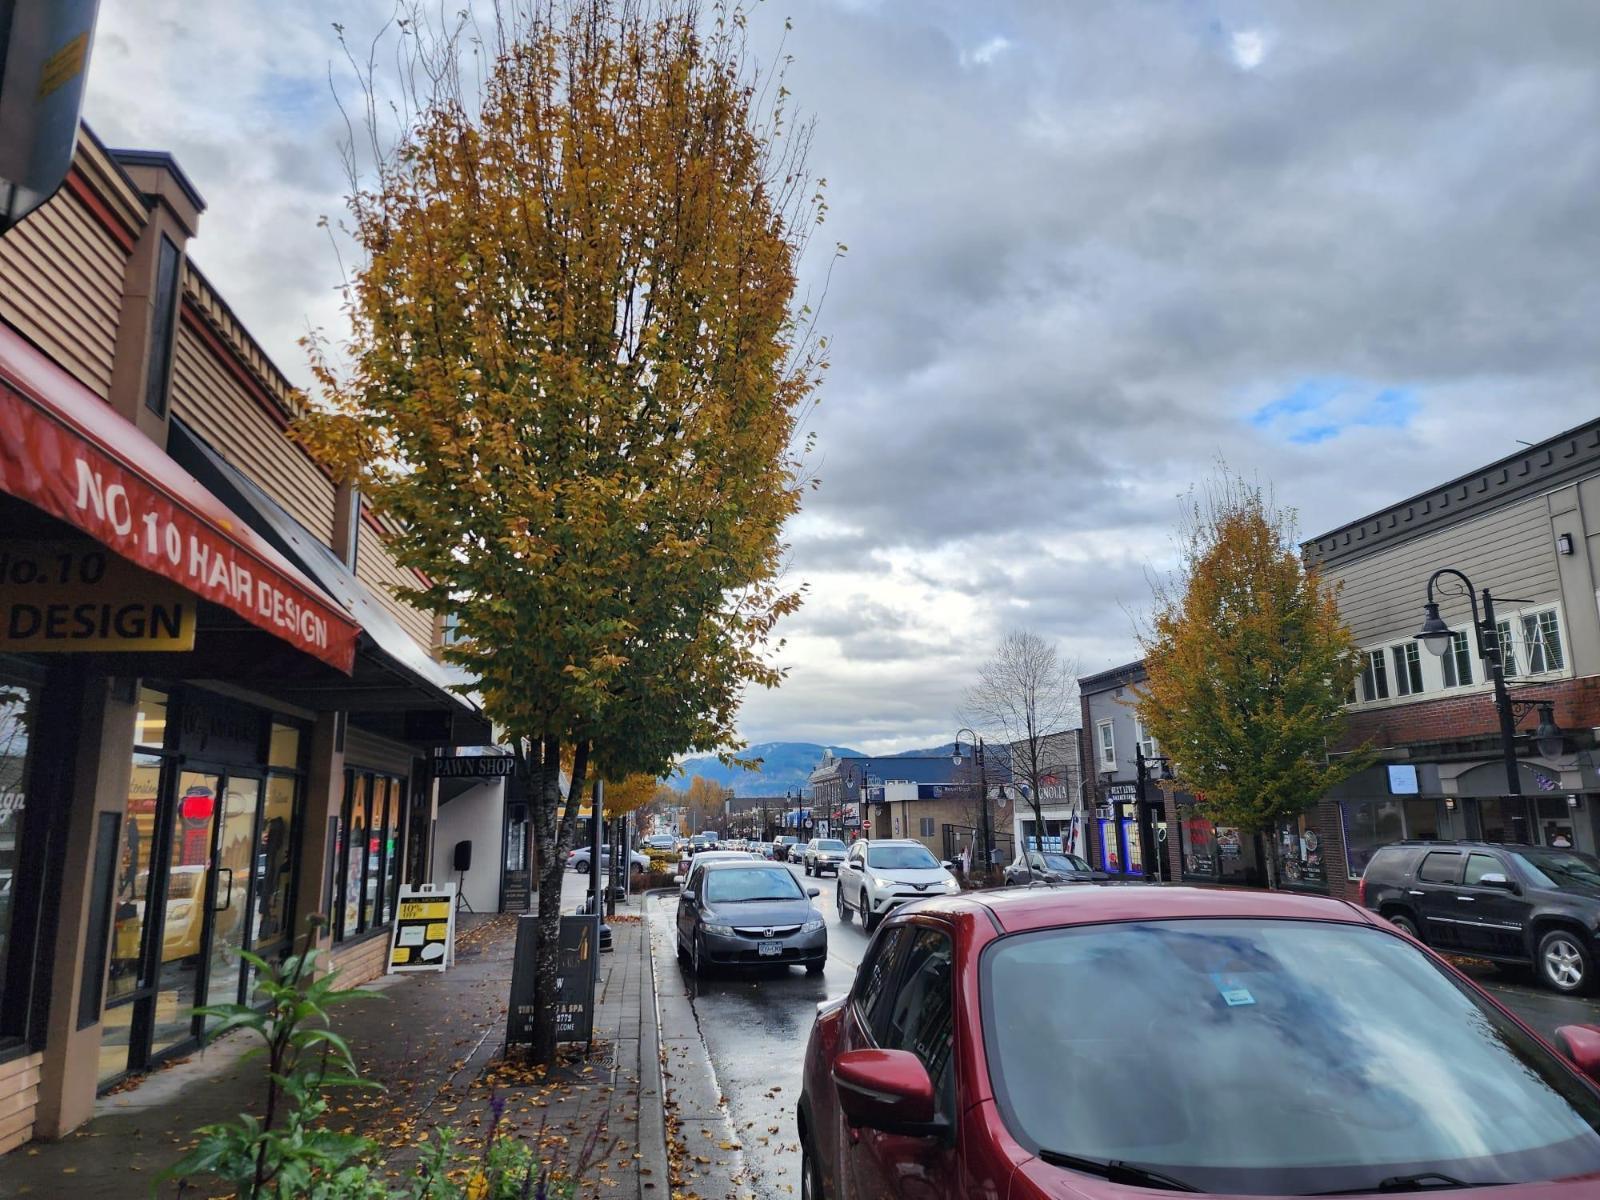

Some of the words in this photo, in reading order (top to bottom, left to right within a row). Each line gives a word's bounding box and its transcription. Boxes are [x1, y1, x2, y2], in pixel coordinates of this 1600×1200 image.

[75, 458, 182, 565] NO.10
[189, 536, 253, 608] HAIR
[258, 580, 328, 649] DESIGN
[8, 603, 183, 640] DESIGN
[434, 758, 474, 776] PAWN
[478, 757, 514, 775] SHOP
[568, 1004, 583, 1013] SPA
[557, 1023, 575, 1031] LCOME
